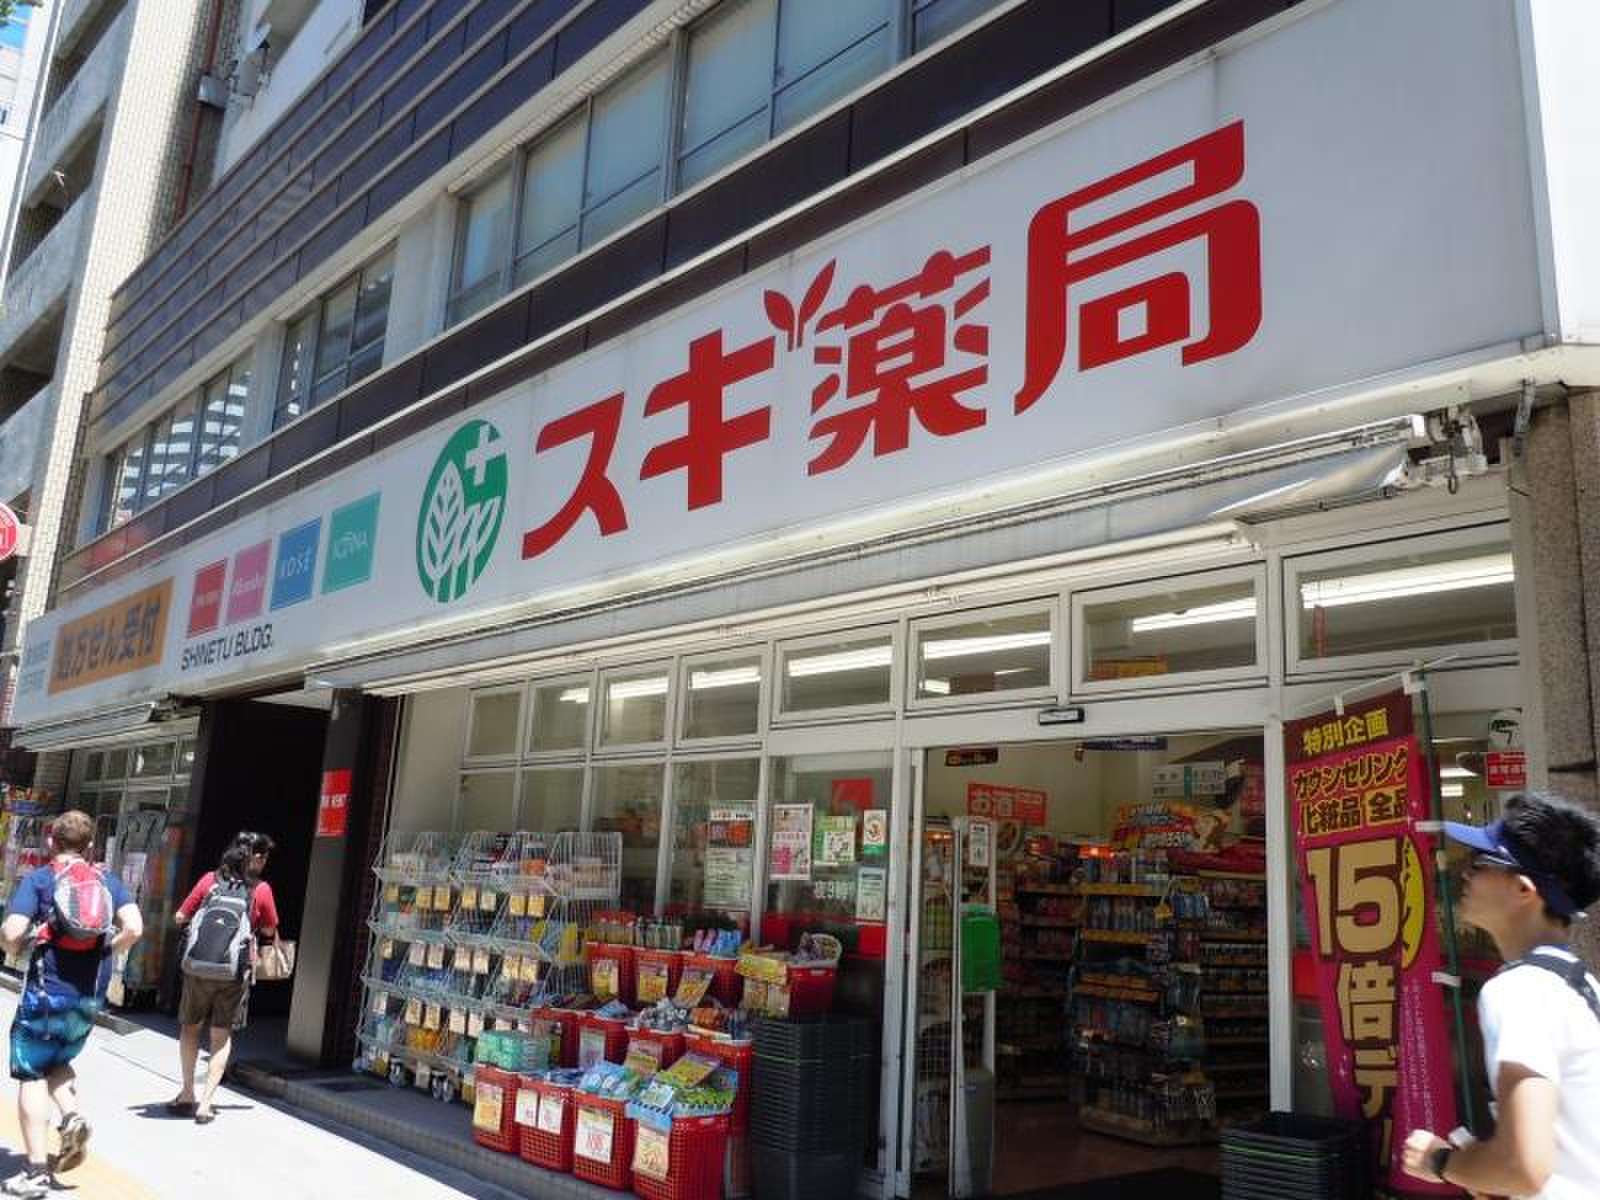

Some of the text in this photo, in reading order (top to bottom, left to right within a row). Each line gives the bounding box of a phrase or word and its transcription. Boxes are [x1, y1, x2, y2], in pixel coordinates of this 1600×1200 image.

[521, 119, 1263, 561] スギ薬局
[234, 623, 274, 657] BLDG.
[1303, 707, 1389, 756] 特別企画
